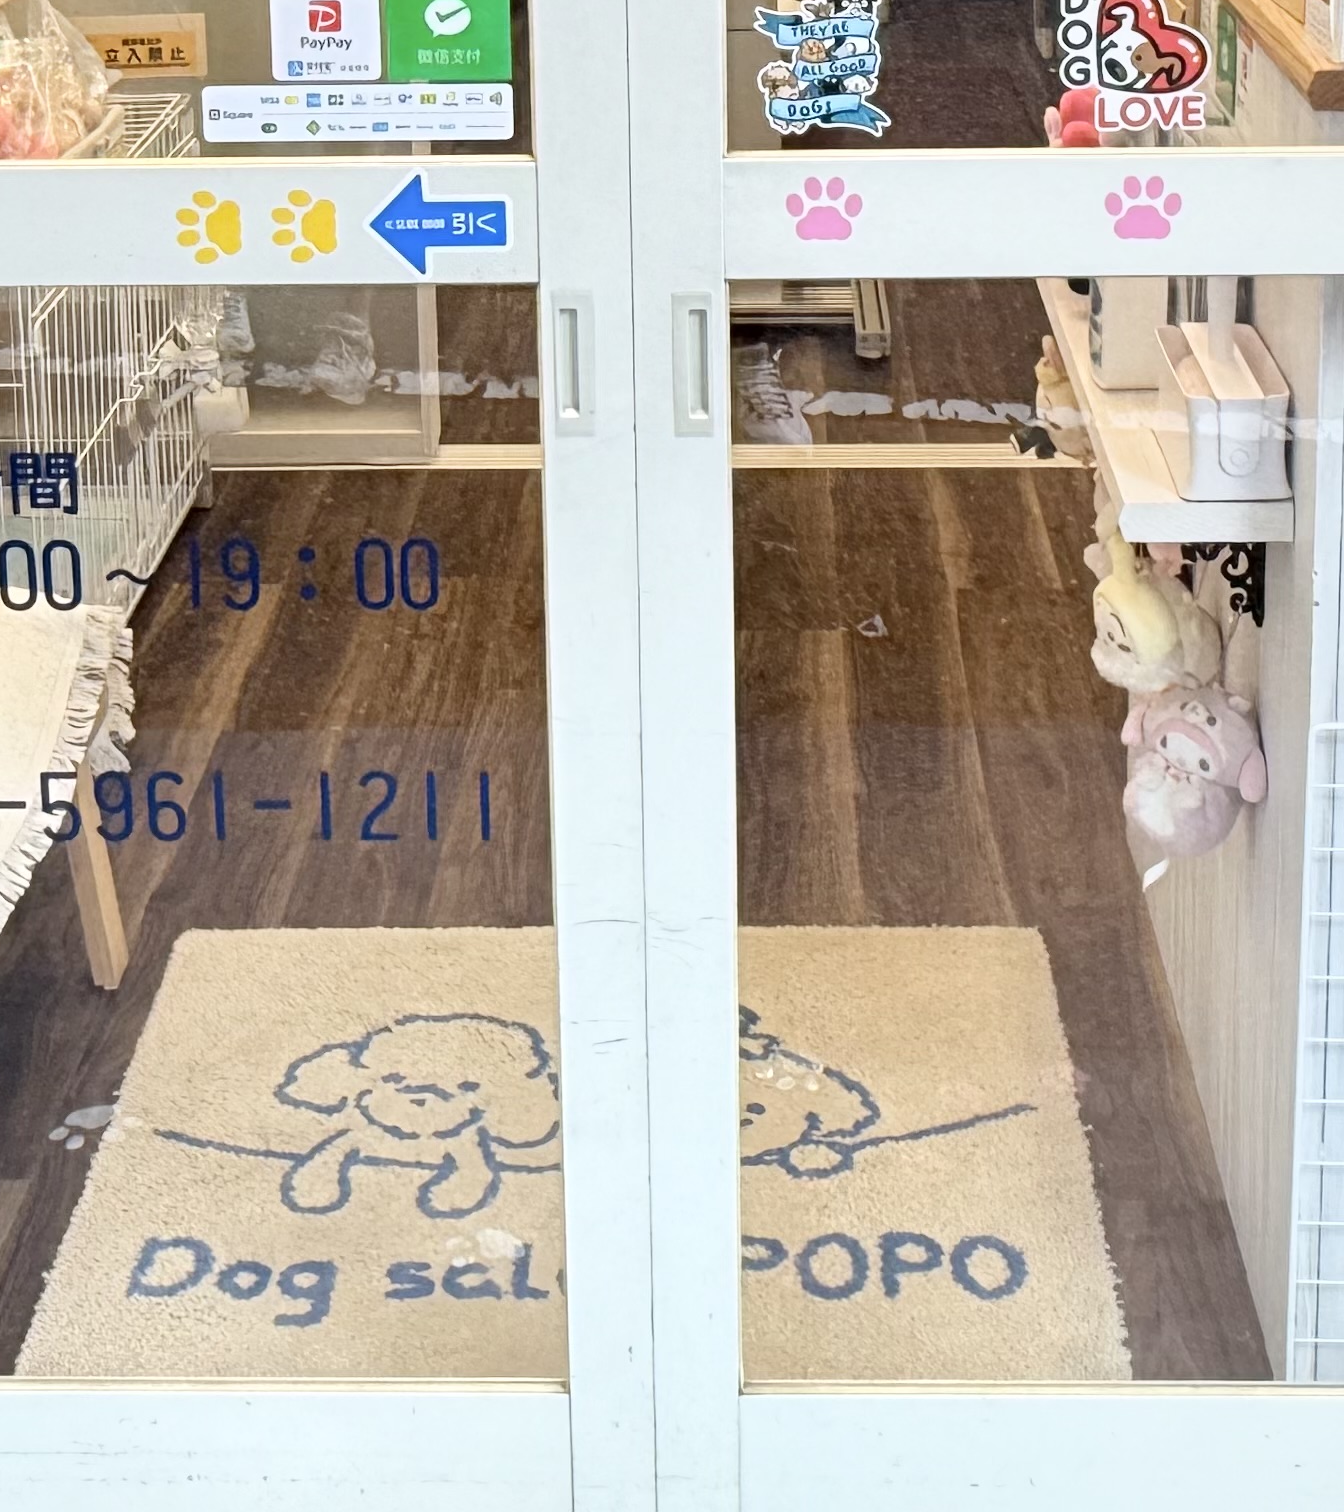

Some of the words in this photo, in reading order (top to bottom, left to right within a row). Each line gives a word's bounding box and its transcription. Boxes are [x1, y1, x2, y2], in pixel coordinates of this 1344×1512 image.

[300, 36, 353, 51] PayPay
[417, 49, 482, 65] 微信支付
[801, 65, 824, 76] ALL
[828, 61, 866, 73] GOOD
[787, 100, 832, 117] DOGS
[1098, 96, 1202, 128] LOVE
[451, 212, 497, 235] 引く
[128, 1236, 337, 1328] Dog
[384, 1243, 564, 1301] sal
